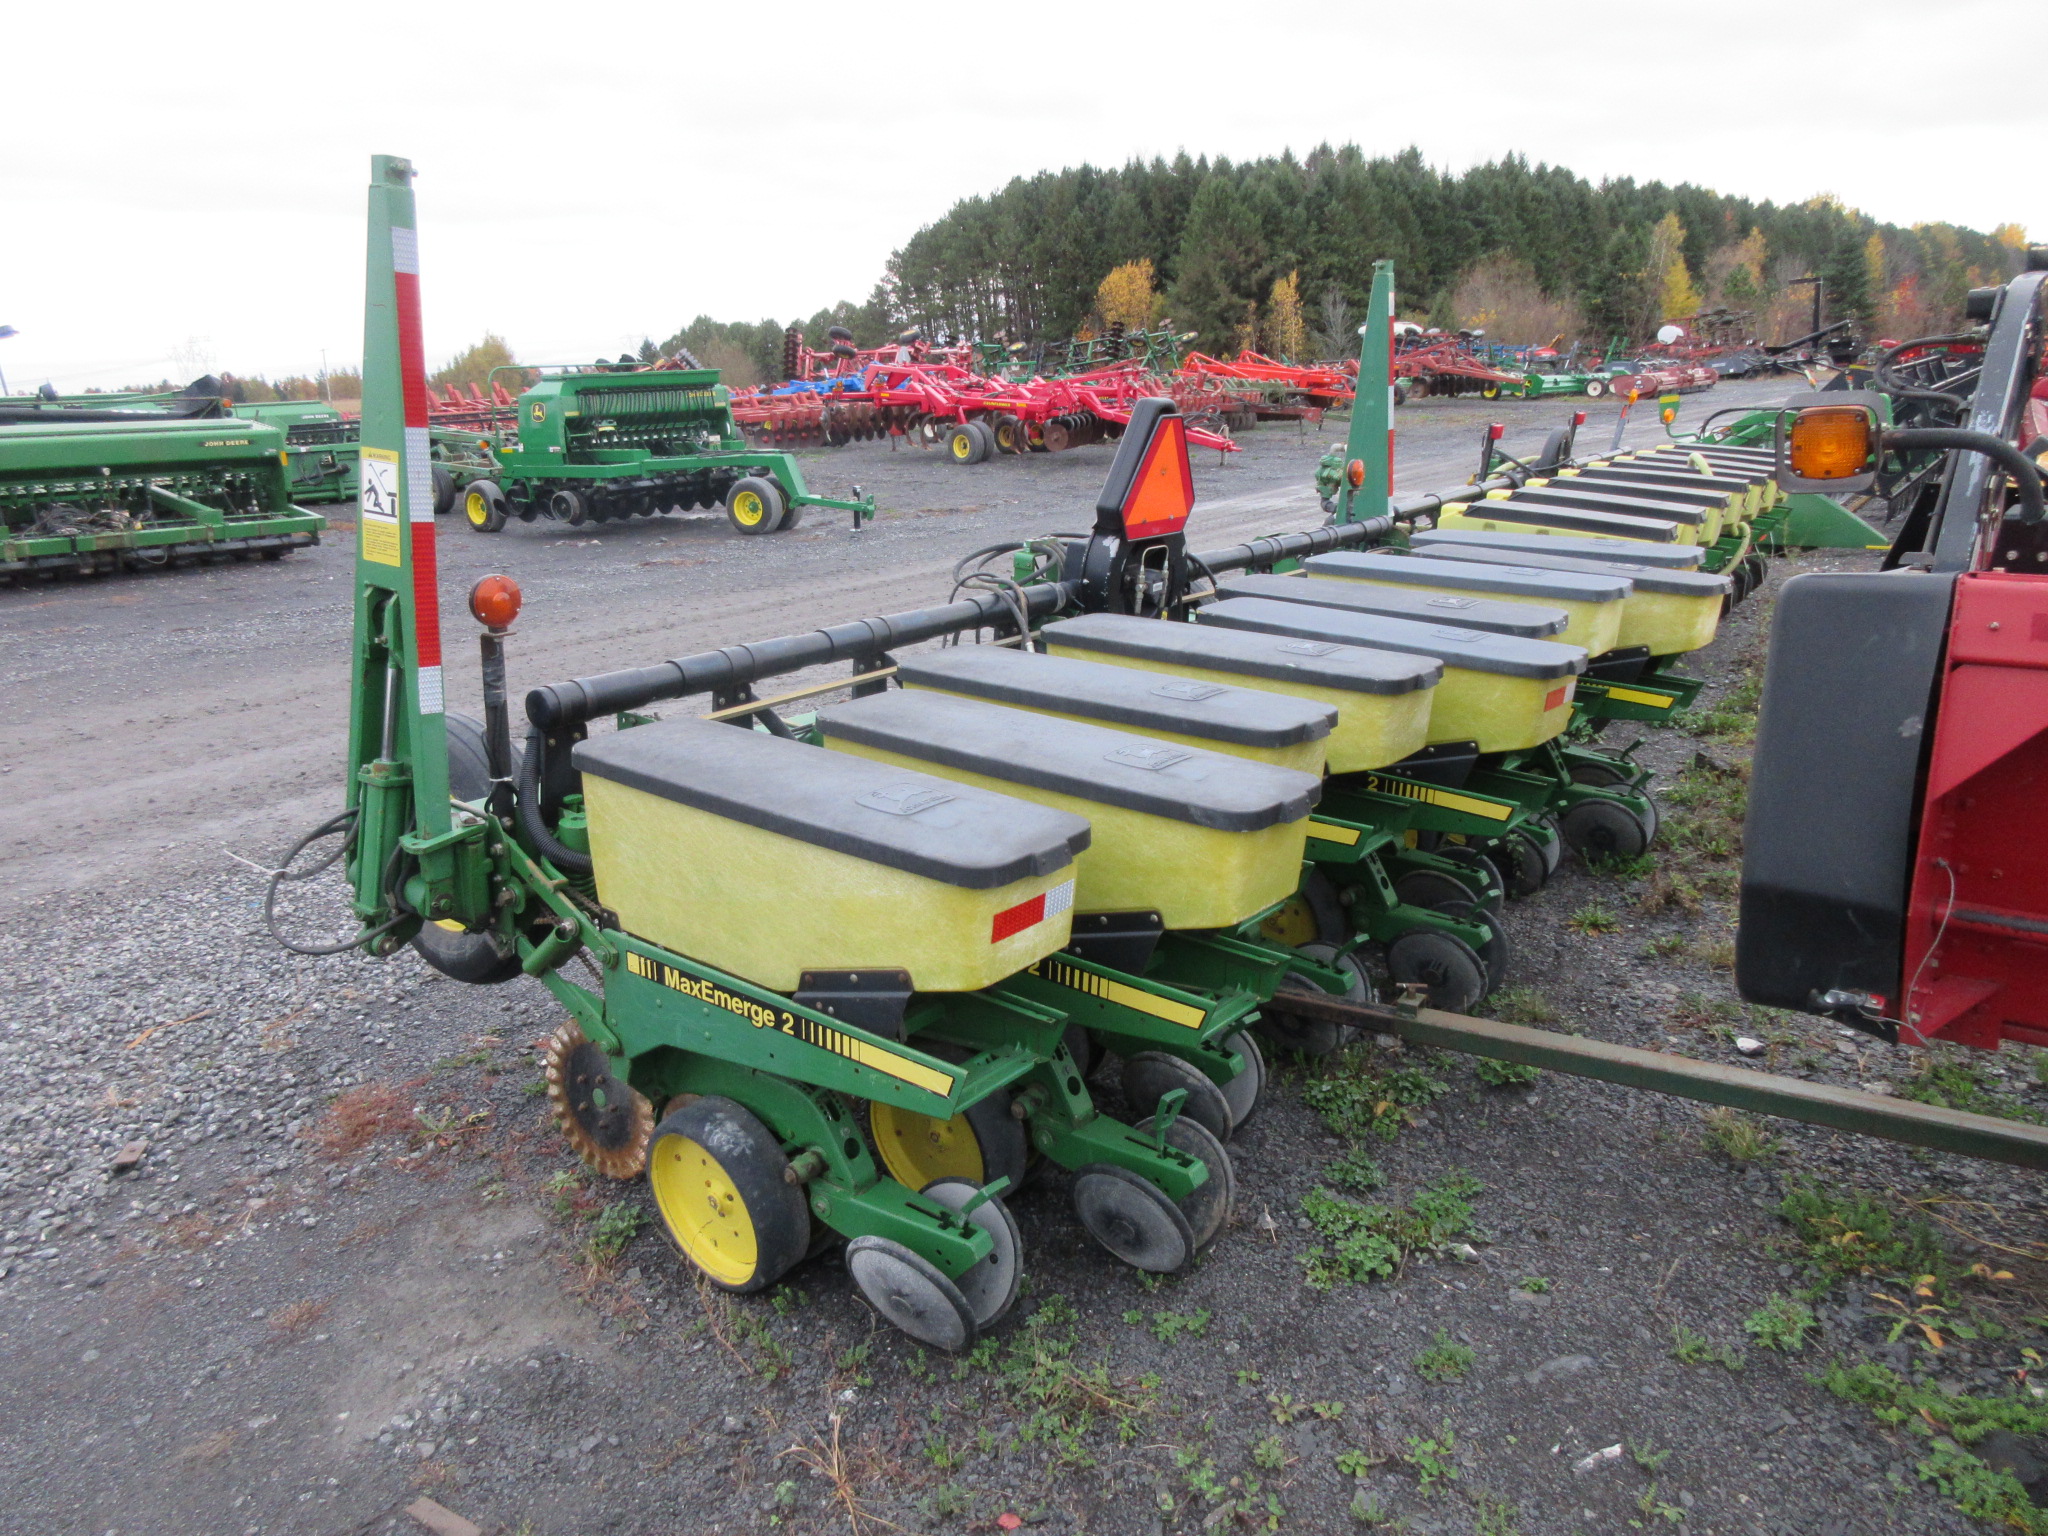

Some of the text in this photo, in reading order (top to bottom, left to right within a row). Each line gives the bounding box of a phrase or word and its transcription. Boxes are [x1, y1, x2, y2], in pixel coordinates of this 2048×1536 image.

[1367, 776, 1379, 792] 2
[664, 966, 795, 1036] MaxEmerge 2
